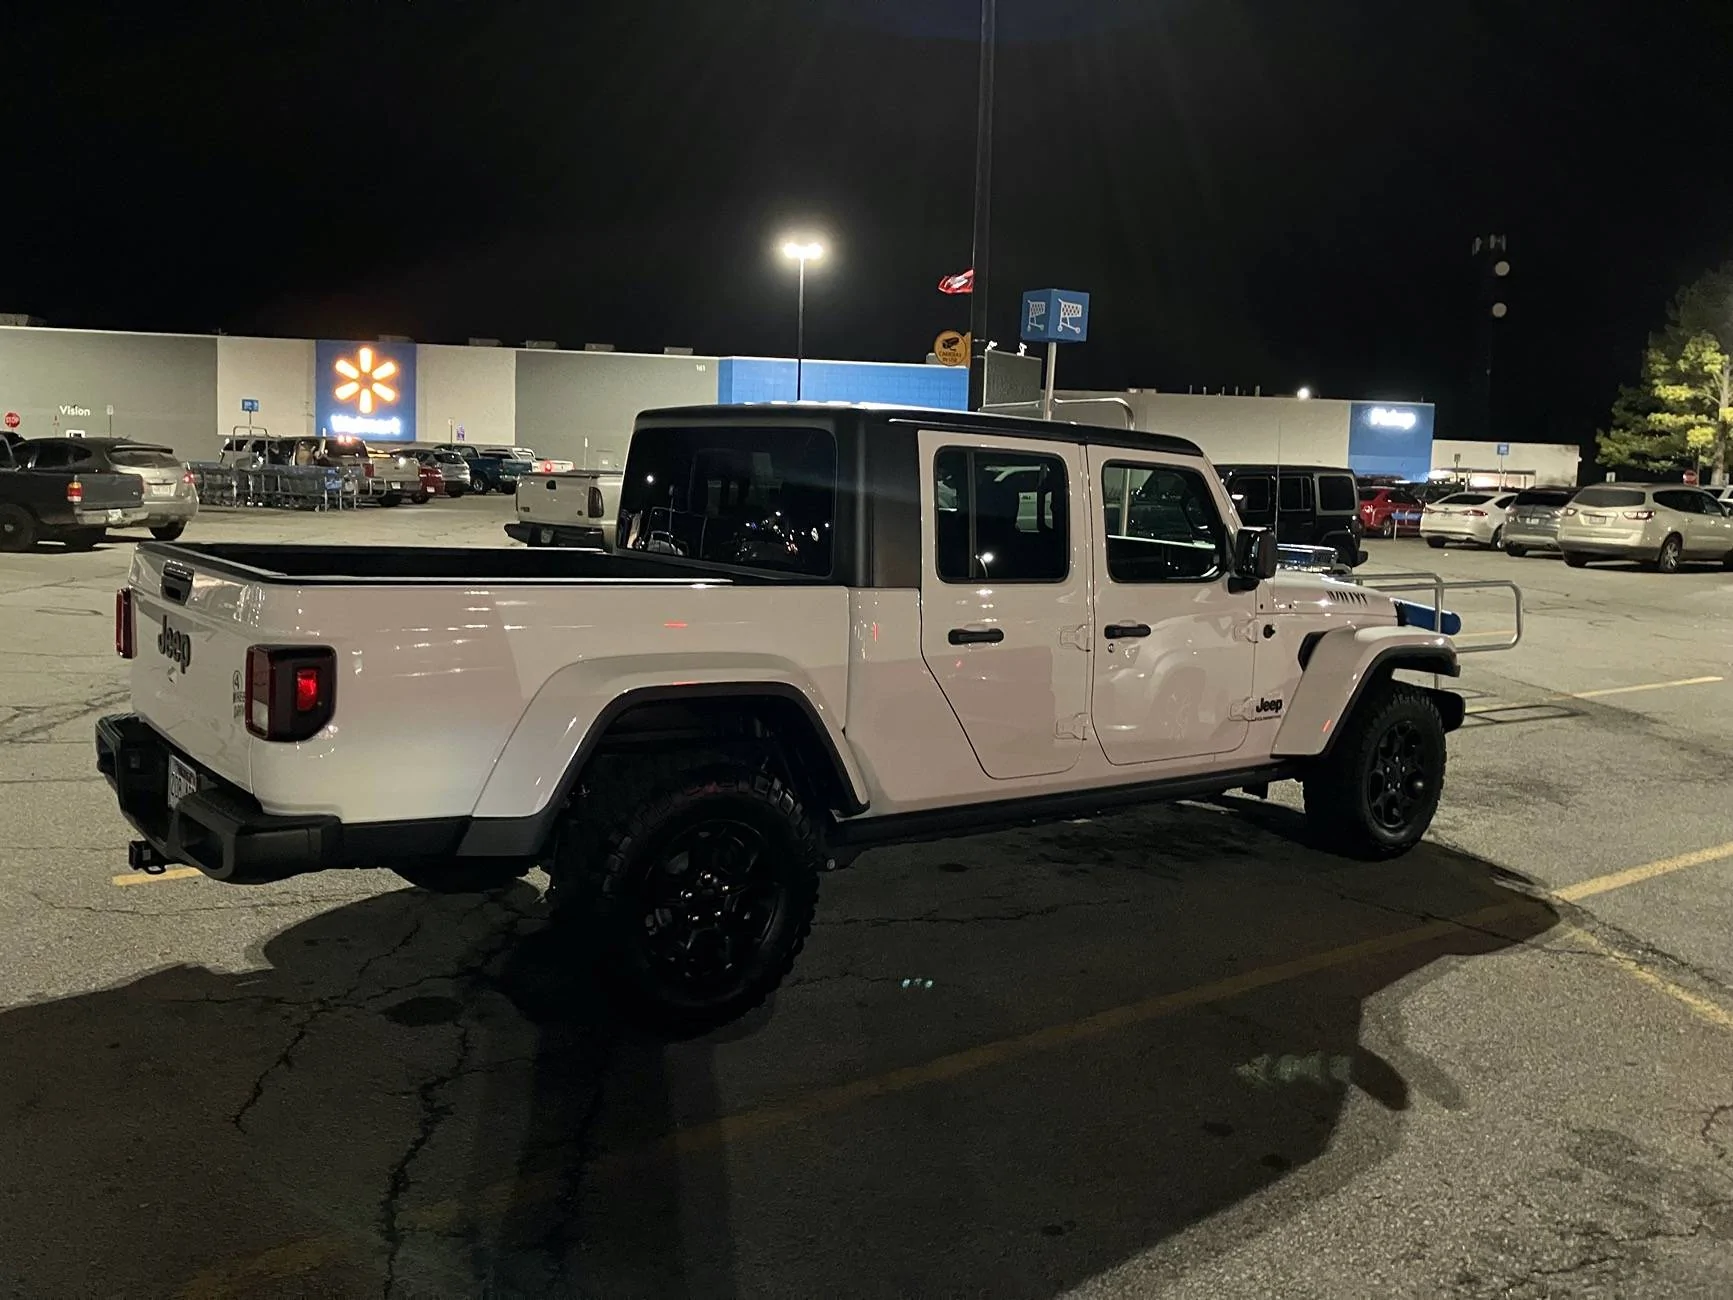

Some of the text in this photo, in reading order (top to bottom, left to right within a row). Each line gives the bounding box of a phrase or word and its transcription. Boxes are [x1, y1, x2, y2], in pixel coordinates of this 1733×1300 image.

[60, 405, 90, 416] Vision
[158, 615, 191, 674] Jeep
[1256, 698, 1283, 714] Jeep
